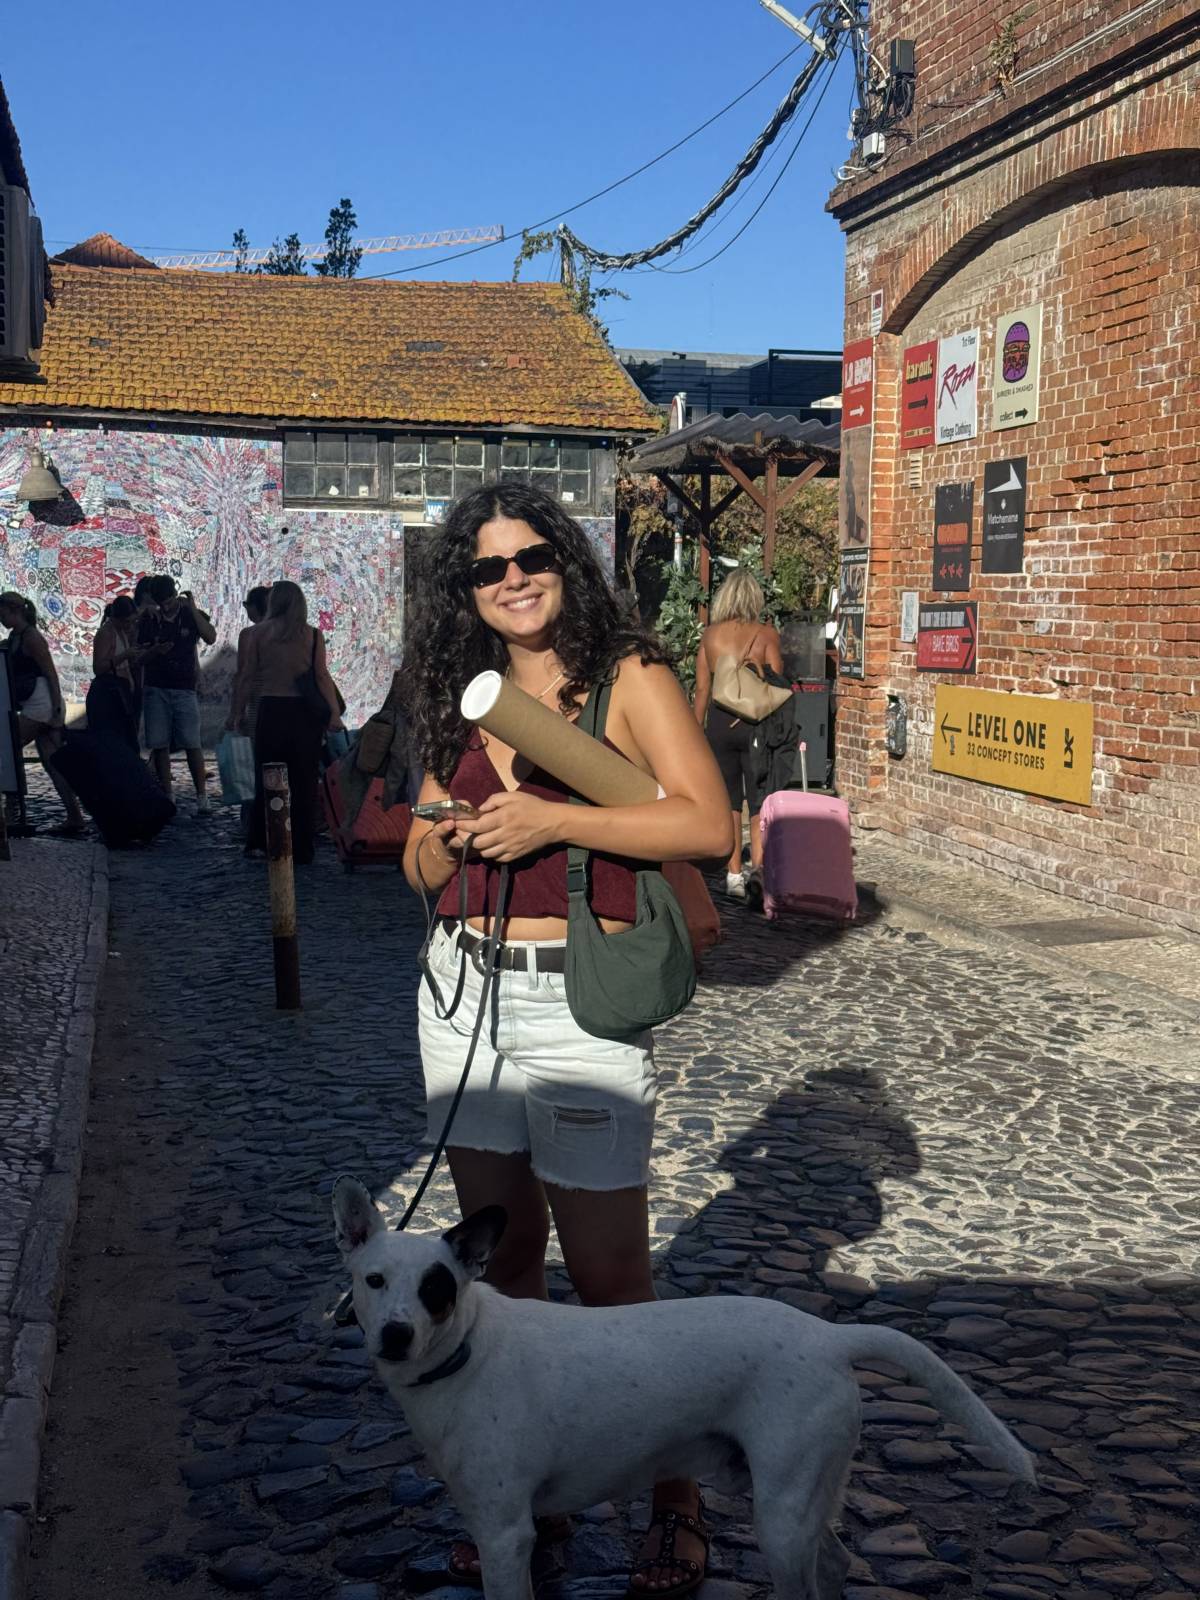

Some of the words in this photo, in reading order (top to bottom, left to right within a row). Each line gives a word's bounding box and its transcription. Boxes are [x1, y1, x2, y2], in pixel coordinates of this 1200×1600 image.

[428, 505, 443, 516] WC
[968, 711, 1008, 743] LEVEL
[1013, 719, 1047, 750] ONE
[976, 744, 1012, 764] CONCEPT
[1013, 751, 1046, 771] STORES
